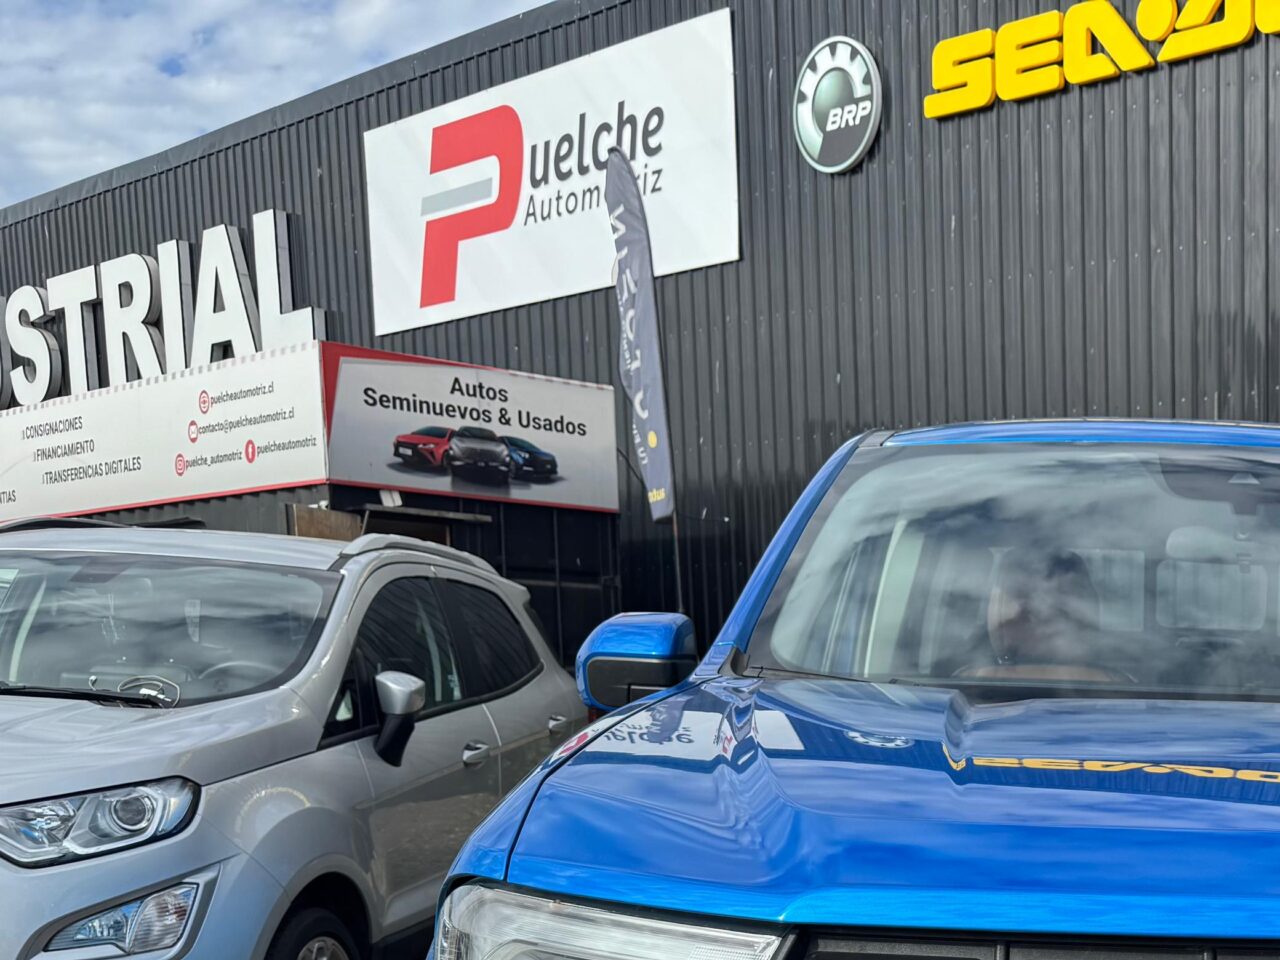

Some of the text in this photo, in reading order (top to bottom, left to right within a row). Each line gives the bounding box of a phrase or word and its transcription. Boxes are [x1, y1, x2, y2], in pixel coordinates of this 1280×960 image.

[826, 100, 872, 131] BRP
[523, 163, 663, 226] Automiz
[0, 208, 320, 408] STRIAL
[210, 381, 274, 407] puelcheautomotriz.cl
[450, 377, 509, 402] Autos
[198, 407, 295, 433] contacto@puelcheautomotriz.cl
[363, 387, 588, 436] Seminuevos & Usados
[26, 416, 83, 439] CONSIGNACIONES
[36, 439, 95, 462] FINANCIAMIENTO
[185, 449, 242, 470] puelche_automotriz
[256, 435, 317, 458] puelcheautomotriz
[45, 456, 142, 484] TRANSFERENCIAS DIGITALES
